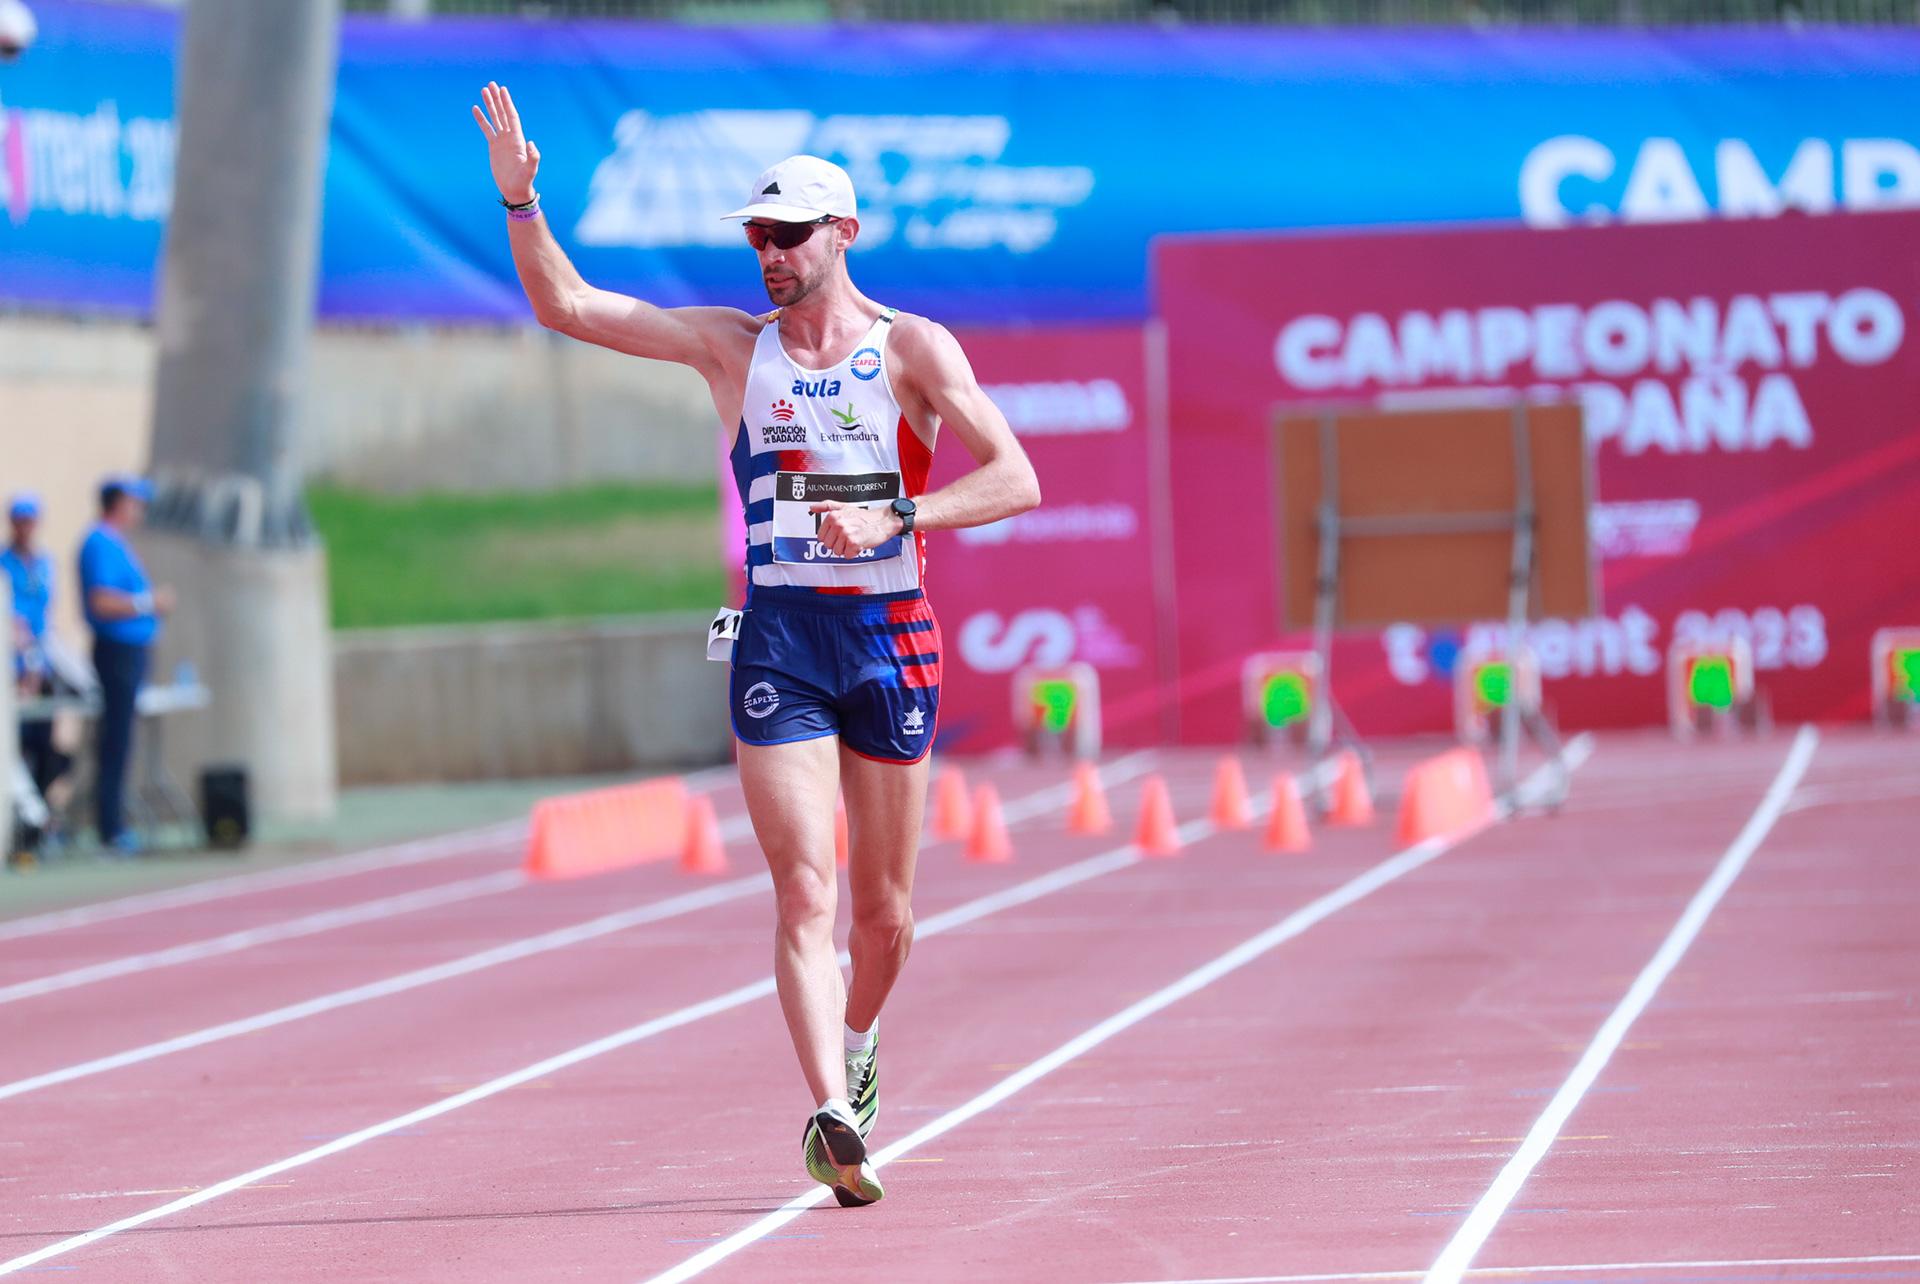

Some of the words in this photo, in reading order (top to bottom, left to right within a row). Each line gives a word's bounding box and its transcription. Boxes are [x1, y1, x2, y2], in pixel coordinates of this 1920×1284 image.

[1275, 289, 1904, 388] CAMPEONATO
[791, 378, 841, 398] aula
[1522, 372, 1814, 454] PAÑA
[762, 424, 806, 436] DIPUTACIÓN
[771, 434, 806, 443] BADAJOZ
[820, 432, 879, 442] Extremadura
[806, 484, 852, 492] AJUNTAMENT
[857, 482, 887, 491] TORRENT
[748, 696, 774, 706] CAPEX
